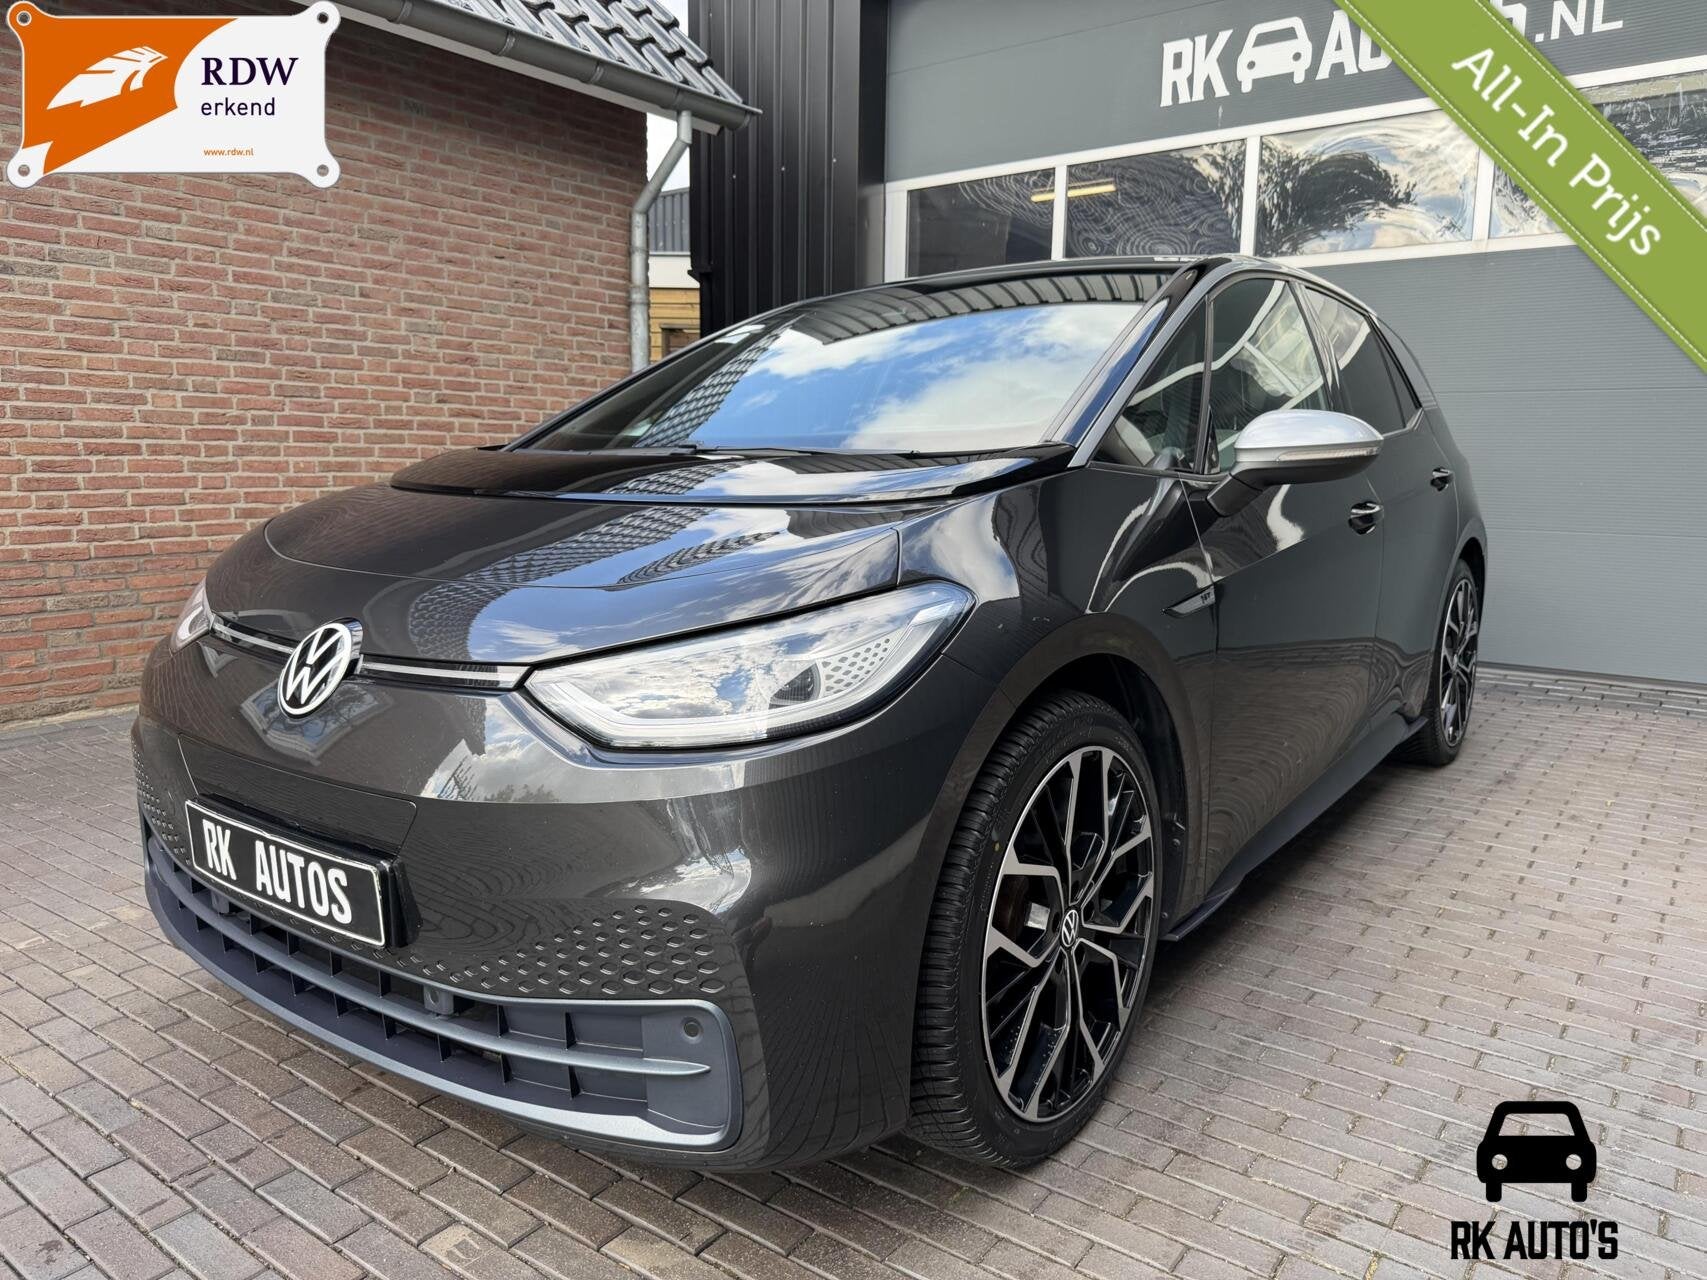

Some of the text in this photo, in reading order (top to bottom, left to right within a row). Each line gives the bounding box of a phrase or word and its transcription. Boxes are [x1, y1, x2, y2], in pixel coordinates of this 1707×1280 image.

[1160, 29, 1234, 107] RK
[202, 818, 352, 924] RK AUTOS
